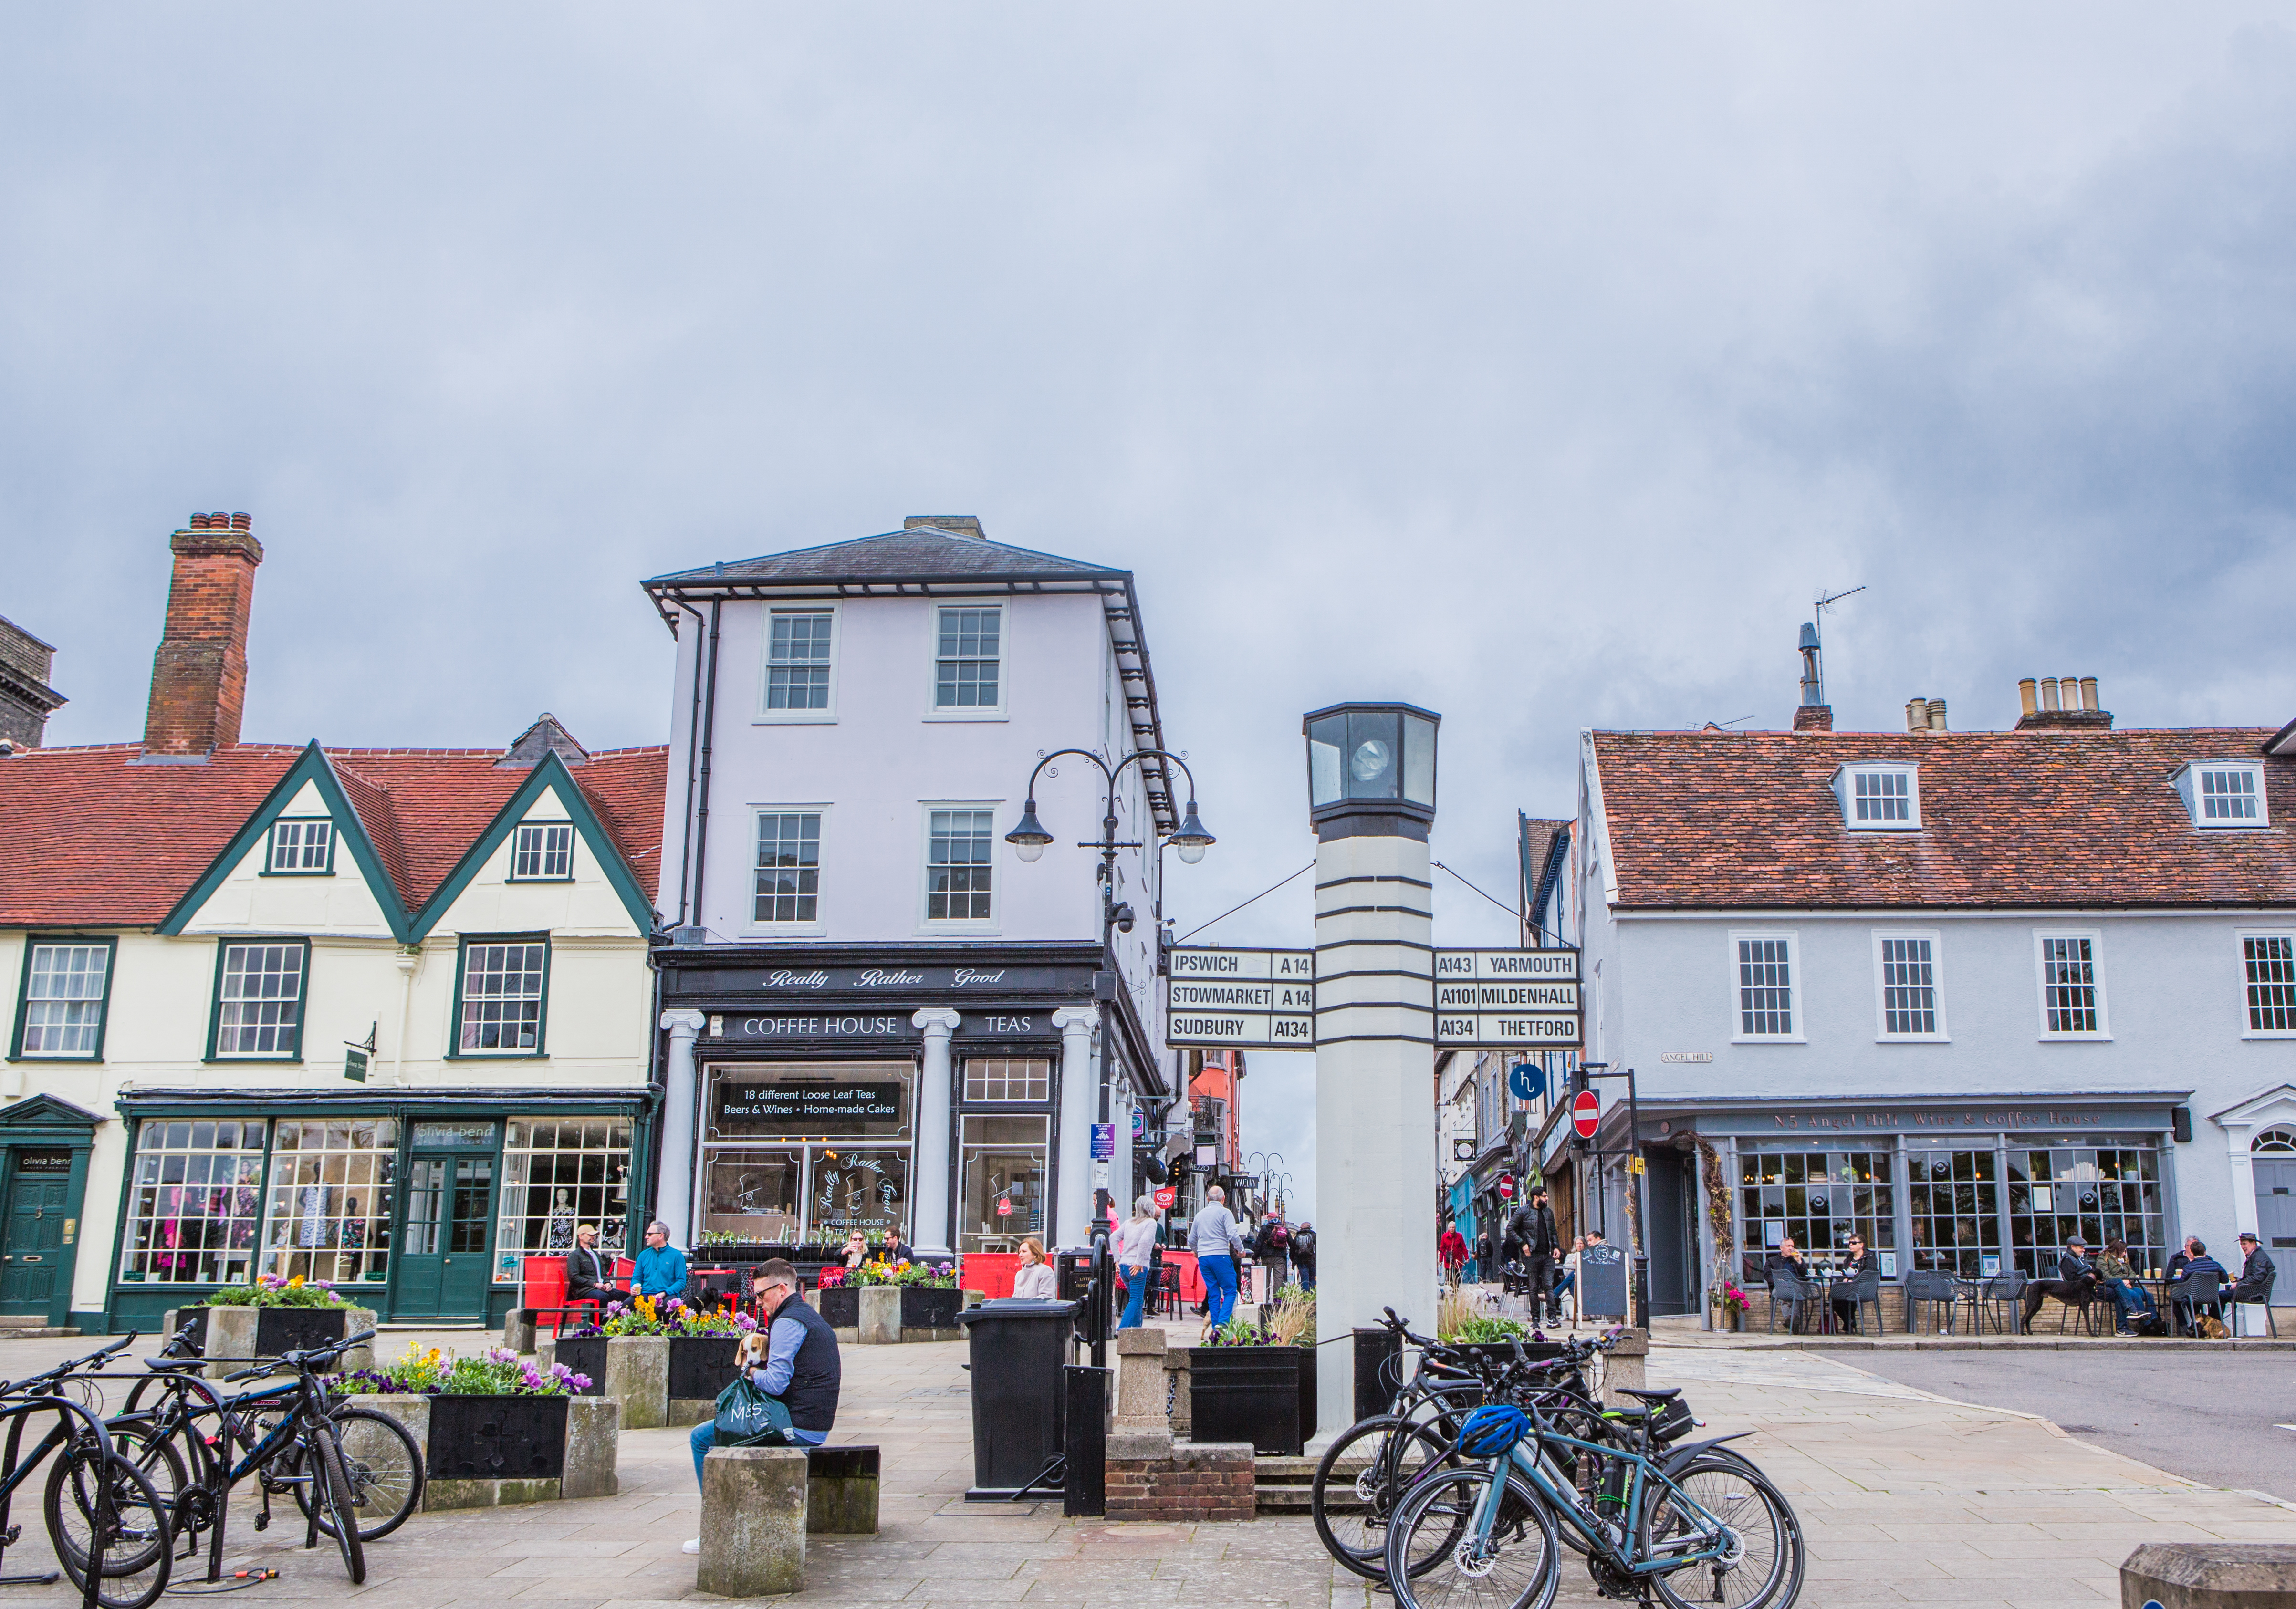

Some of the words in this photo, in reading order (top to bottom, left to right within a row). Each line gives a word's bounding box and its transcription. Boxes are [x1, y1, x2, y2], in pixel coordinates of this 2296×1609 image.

[1175, 956, 1238, 973] IPSWICH
[1280, 958, 1291, 974] A
[1294, 958, 1309, 974] 14
[1438, 958, 1471, 973] A143
[1491, 957, 1572, 973] YARMOUTH
[763, 969, 829, 989] Really
[854, 969, 924, 986] Rather
[951, 968, 1005, 987] Good
[1173, 987, 1271, 1004] STOWMARKET
[1282, 990, 1294, 1005] A
[1296, 990, 1311, 1005] 14
[1441, 989, 1476, 1004] A1101
[1482, 988, 1574, 1004] MILDENHALL
[744, 1018, 817, 1035] COFFEE
[825, 1017, 896, 1034] HOUSE
[986, 1017, 1031, 1032] TEAS
[1174, 1019, 1243, 1036] SUDBURY
[1274, 1021, 1308, 1038] A134
[1440, 1019, 1473, 1036] A134
[1498, 1020, 1574, 1036] THETFORD
[1664, 1053, 1689, 1061] ANGEL
[1693, 1053, 1710, 1061] HILL
[745, 1090, 756, 1100] 18
[759, 1090, 799, 1100] different
[803, 1090, 830, 1100] Loose
[834, 1090, 853, 1100] Leaf
[856, 1090, 875, 1100] Teas
[724, 1104, 749, 1114] Beers
[752, 1104, 760, 1114] &
[763, 1104, 793, 1114] Wines
[804, 1104, 864, 1114] Home-made
[867, 1104, 895, 1114] Cakes
[1808, 1114, 1856, 1131] Angel
[1865, 1114, 1898, 1127] Hill
[1913, 1113, 1955, 1126] Wine
[1964, 1113, 1975, 1125] &
[1984, 1111, 2039, 1129] Coffee
[2049, 1112, 2100, 1124] House
[418, 1127, 453, 1137] olivia
[459, 1127, 492, 1137] benn
[23, 1156, 47, 1164] olivia
[841, 1152, 885, 1173] Rather
[1636, 1159, 1644, 1173] H
[819, 1170, 840, 1216] Really
[877, 1178, 897, 1215] Good
[731, 1403, 762, 1422] M&S
